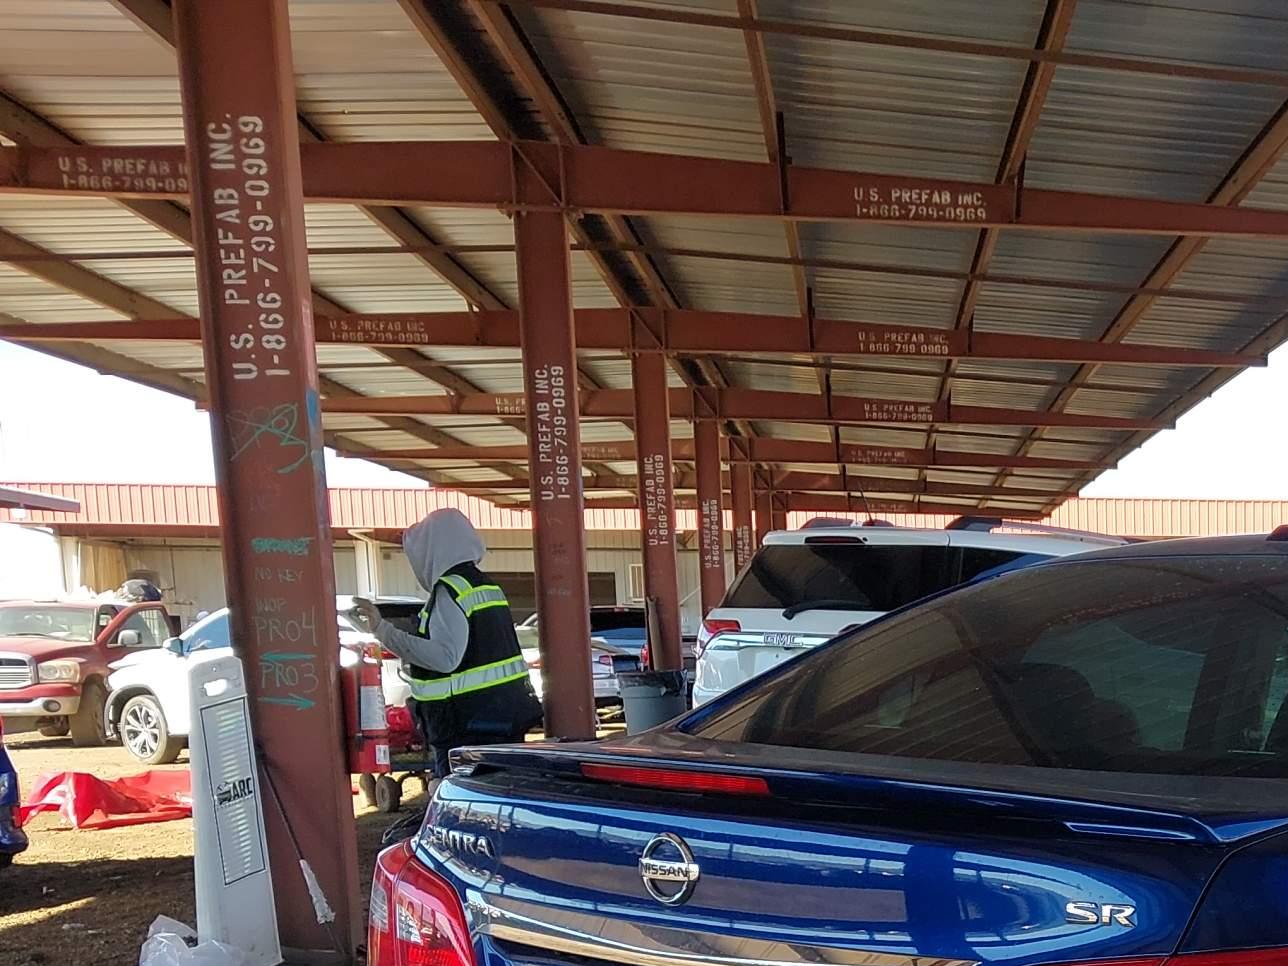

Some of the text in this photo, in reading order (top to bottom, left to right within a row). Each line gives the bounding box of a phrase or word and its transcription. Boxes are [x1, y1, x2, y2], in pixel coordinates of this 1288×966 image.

[101, 157, 170, 175] PREFAB
[855, 202, 988, 220] 1-866-799-0969
[891, 188, 951, 205] PREFAB
[957, 192, 988, 207] INC.
[206, 112, 258, 379] U.S. PREFAB INC.
[238, 115, 290, 376] 1-866-799-0969
[534, 363, 549, 395] INC.
[536, 401, 552, 463] PREFAB
[550, 364, 570, 499] 1-866-799-0969
[645, 479, 657, 520] PREFAB
[763, 632, 804, 647] GMC
[420, 823, 496, 859] SENTRA
[640, 861, 688, 878] NISSAN
[1065, 900, 1137, 928] SR
